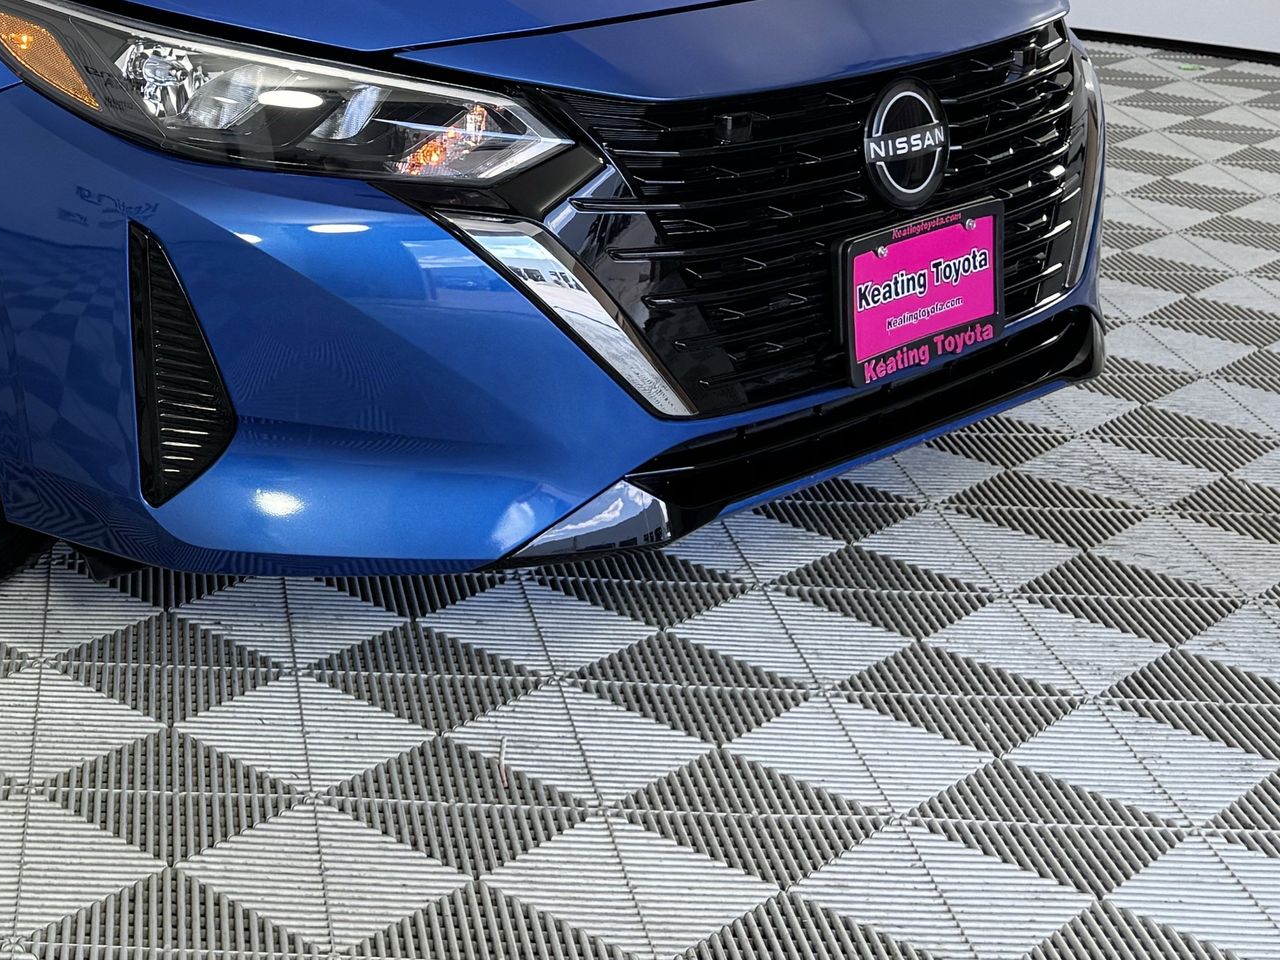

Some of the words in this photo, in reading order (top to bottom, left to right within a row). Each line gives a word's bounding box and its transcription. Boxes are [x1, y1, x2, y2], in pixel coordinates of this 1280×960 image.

[869, 126, 945, 159] NISSAN
[857, 271, 926, 310] Keating
[931, 249, 988, 285] Toyota
[864, 344, 930, 383] Keating
[934, 323, 993, 355] Toyota
